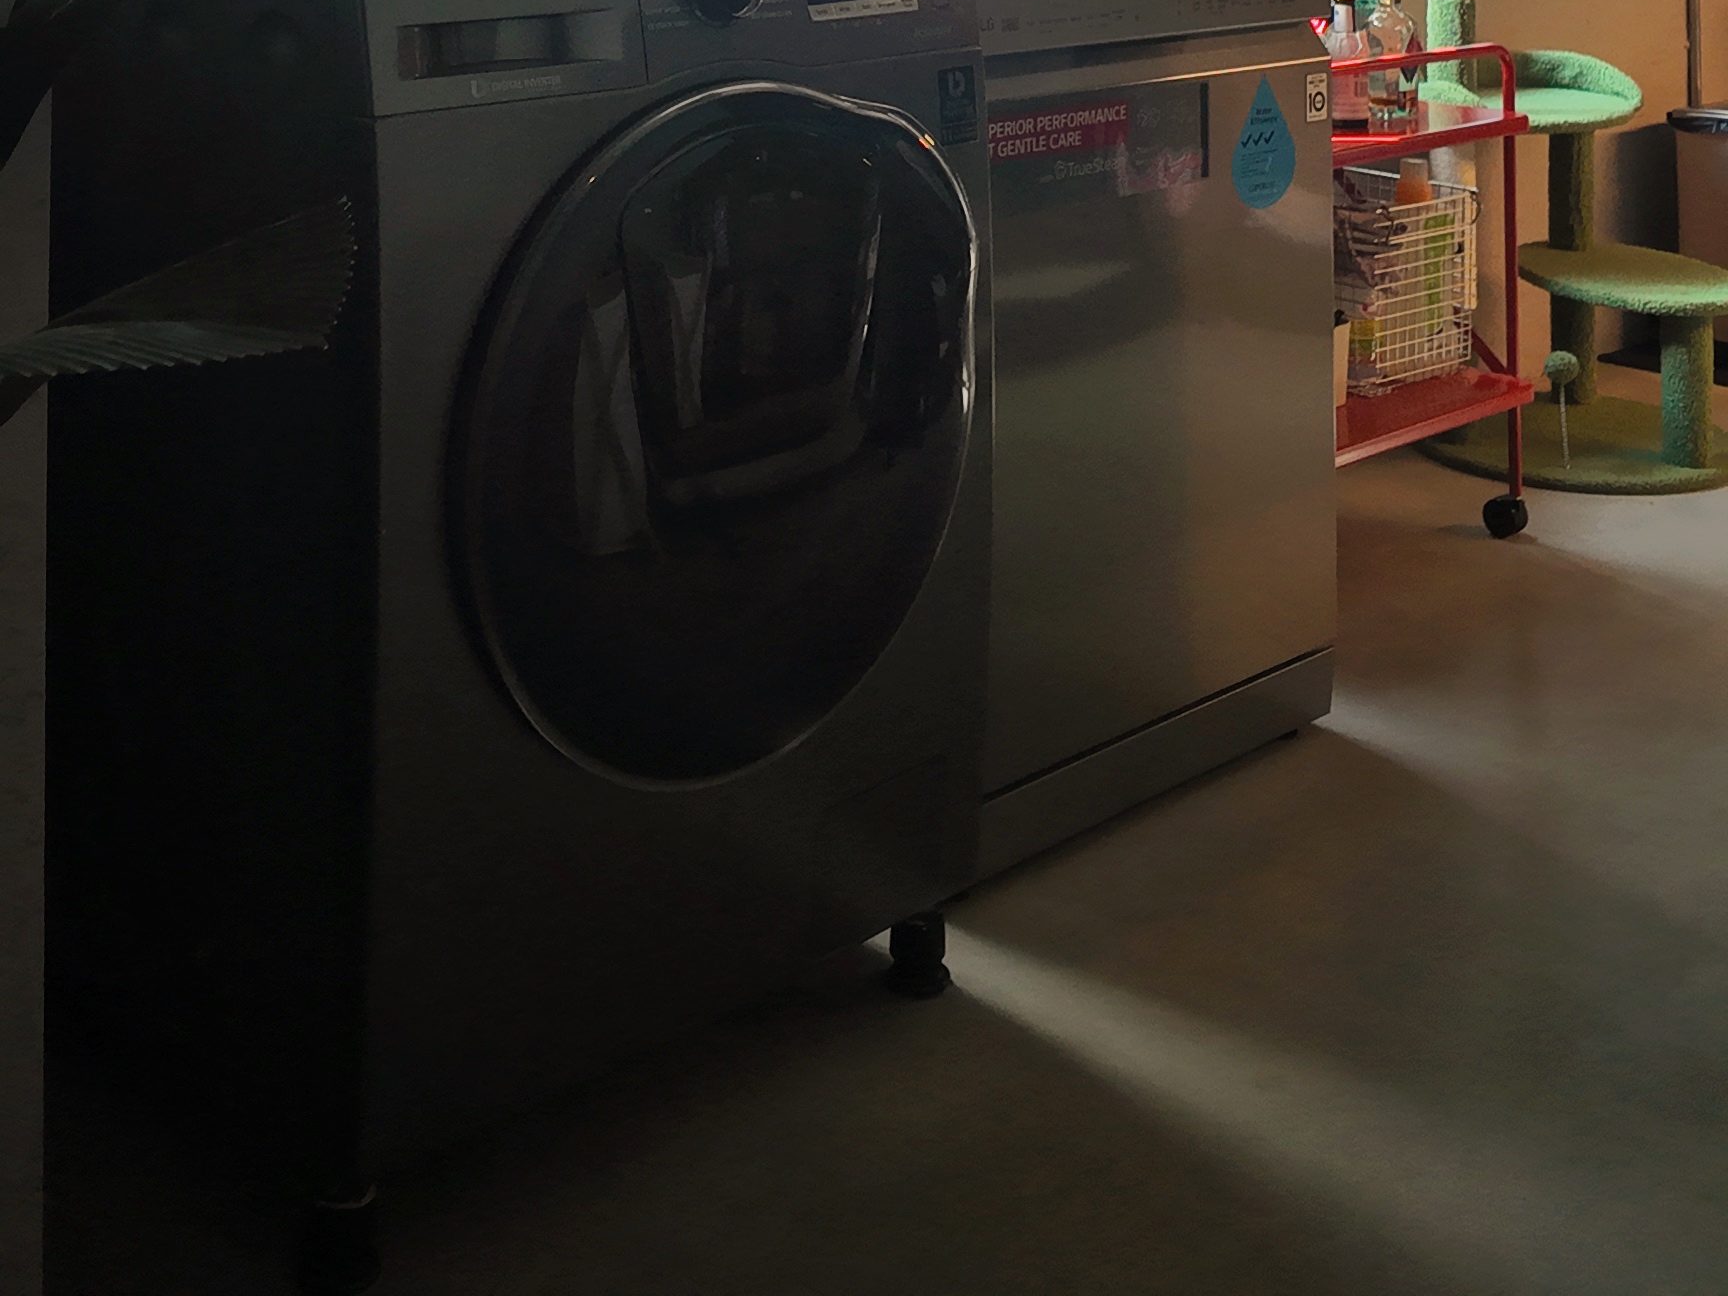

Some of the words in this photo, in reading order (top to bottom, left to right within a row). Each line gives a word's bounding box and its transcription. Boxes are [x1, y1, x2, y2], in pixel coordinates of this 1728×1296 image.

[1308, 90, 1326, 114] 10
[988, 118, 1035, 140] PERIOR
[1036, 104, 1128, 133] PERFORMANCE
[997, 135, 1047, 157] GENTLE
[1049, 130, 1083, 150] CARE
